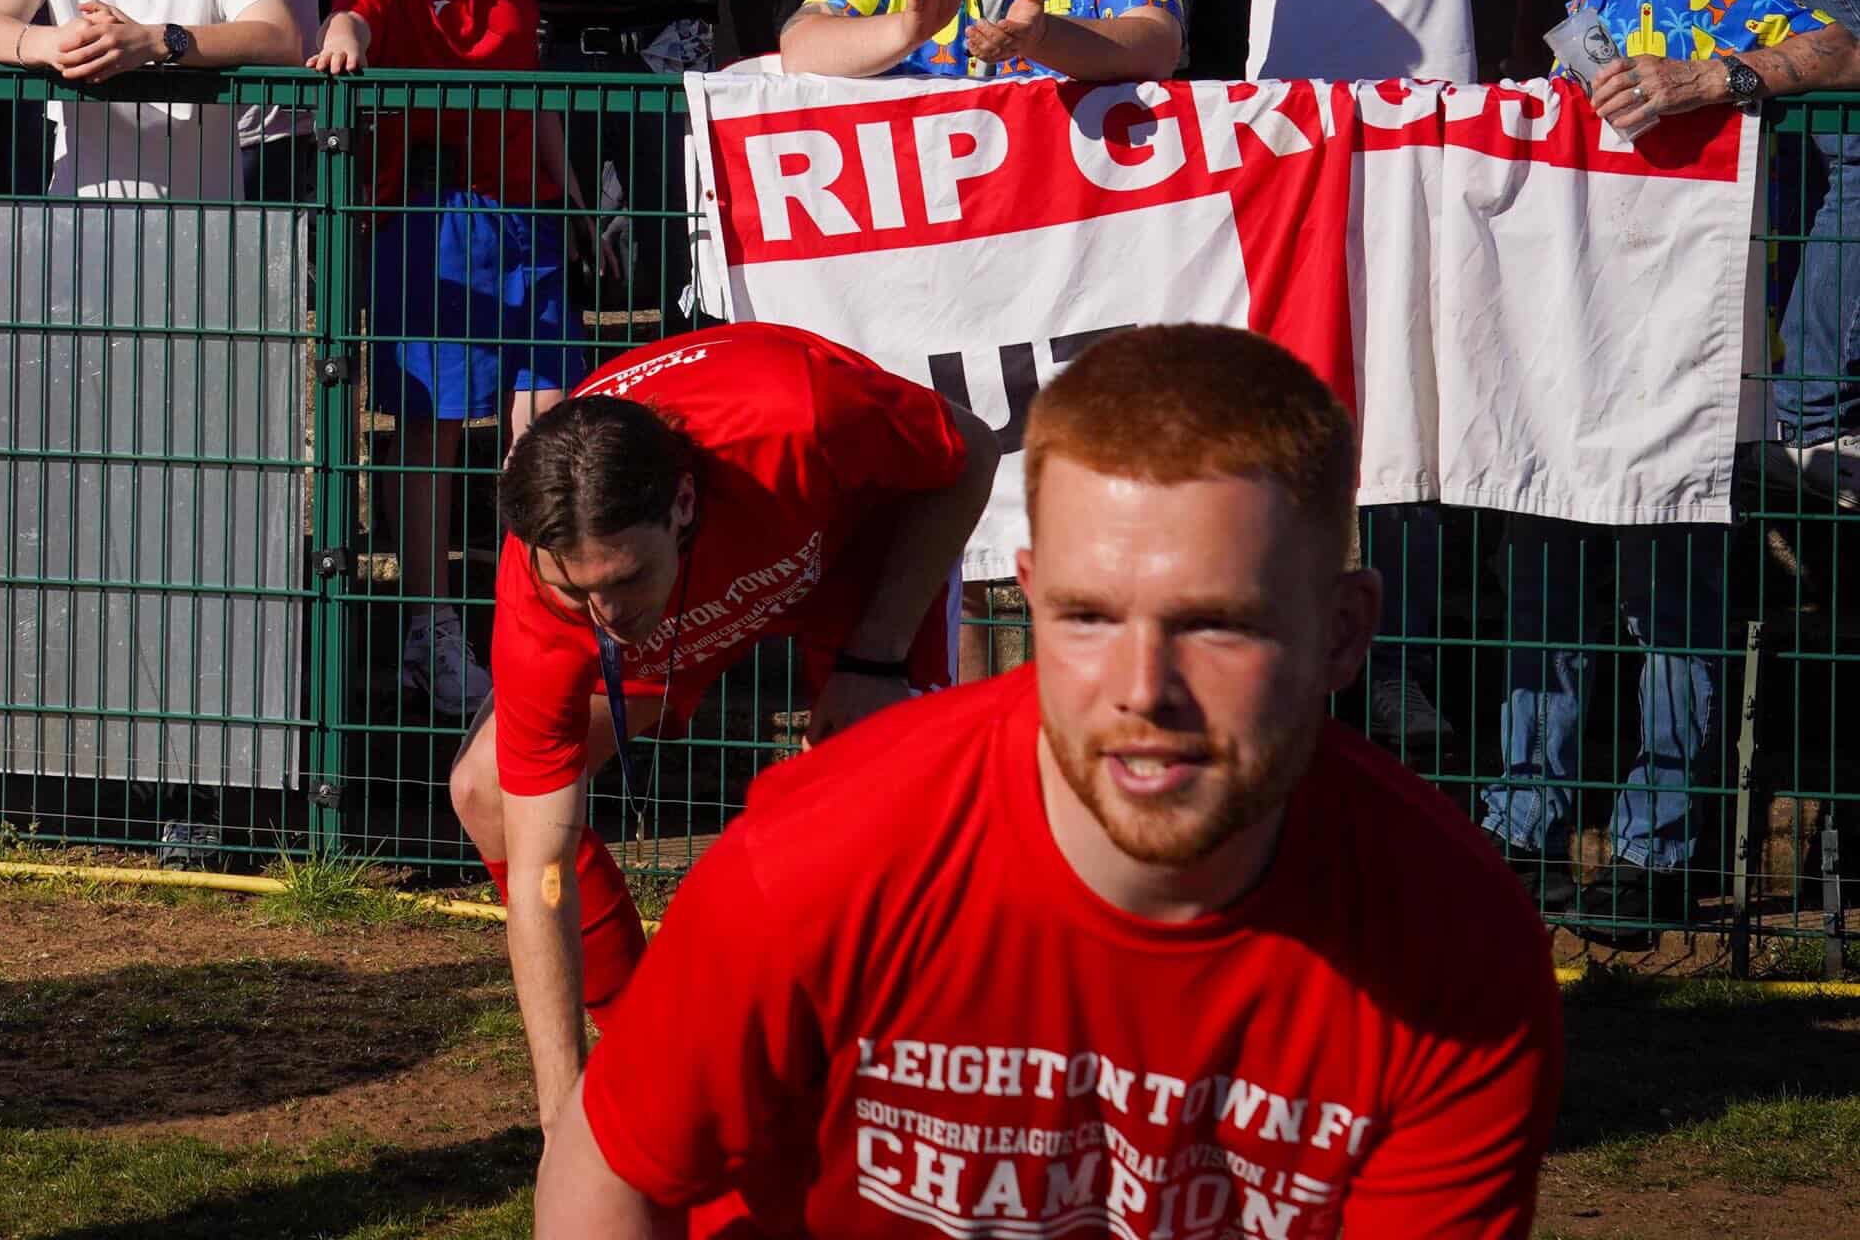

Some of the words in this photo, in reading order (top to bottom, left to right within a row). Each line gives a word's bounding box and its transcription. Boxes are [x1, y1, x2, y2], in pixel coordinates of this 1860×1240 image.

[744, 107, 1009, 243] RIP
[725, 557, 801, 605] TOWN
[856, 1037, 1136, 1115] LEIGHTON
[1144, 1071, 1308, 1144] TOWN
[856, 1098, 981, 1154] SOUTHERN
[983, 1126, 1077, 1157] LEAGUE
